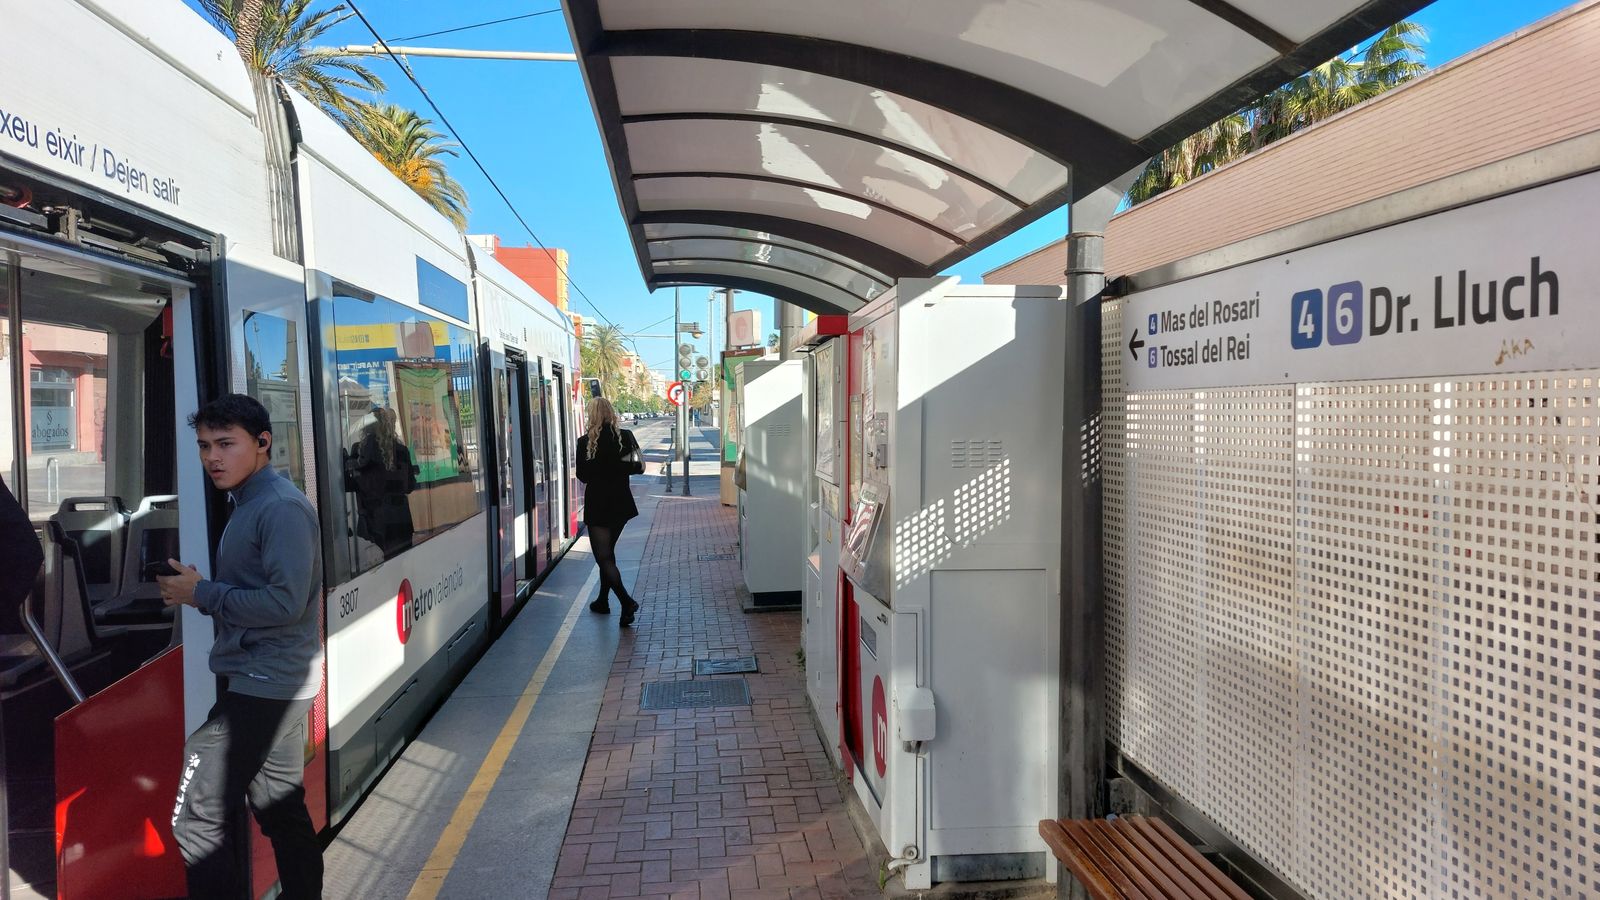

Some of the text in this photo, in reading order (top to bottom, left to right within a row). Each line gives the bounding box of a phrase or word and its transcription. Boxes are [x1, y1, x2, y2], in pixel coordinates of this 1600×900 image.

[46, 127, 85, 167] eixir
[91, 143, 98, 173] /
[103, 148, 149, 194] Dejen
[152, 177, 181, 207] salir
[1161, 310, 1186, 334] Mas
[1189, 301, 1209, 329] del
[1213, 290, 1260, 325] Rosari
[1298, 255, 1560, 339] 4 6 Dr. Lluch
[1160, 340, 1198, 368] Tossal
[1202, 336, 1223, 364] del
[1227, 332, 1250, 361] Rei
[31, 423, 70, 442] abogados
[339, 587, 359, 619] 3807
